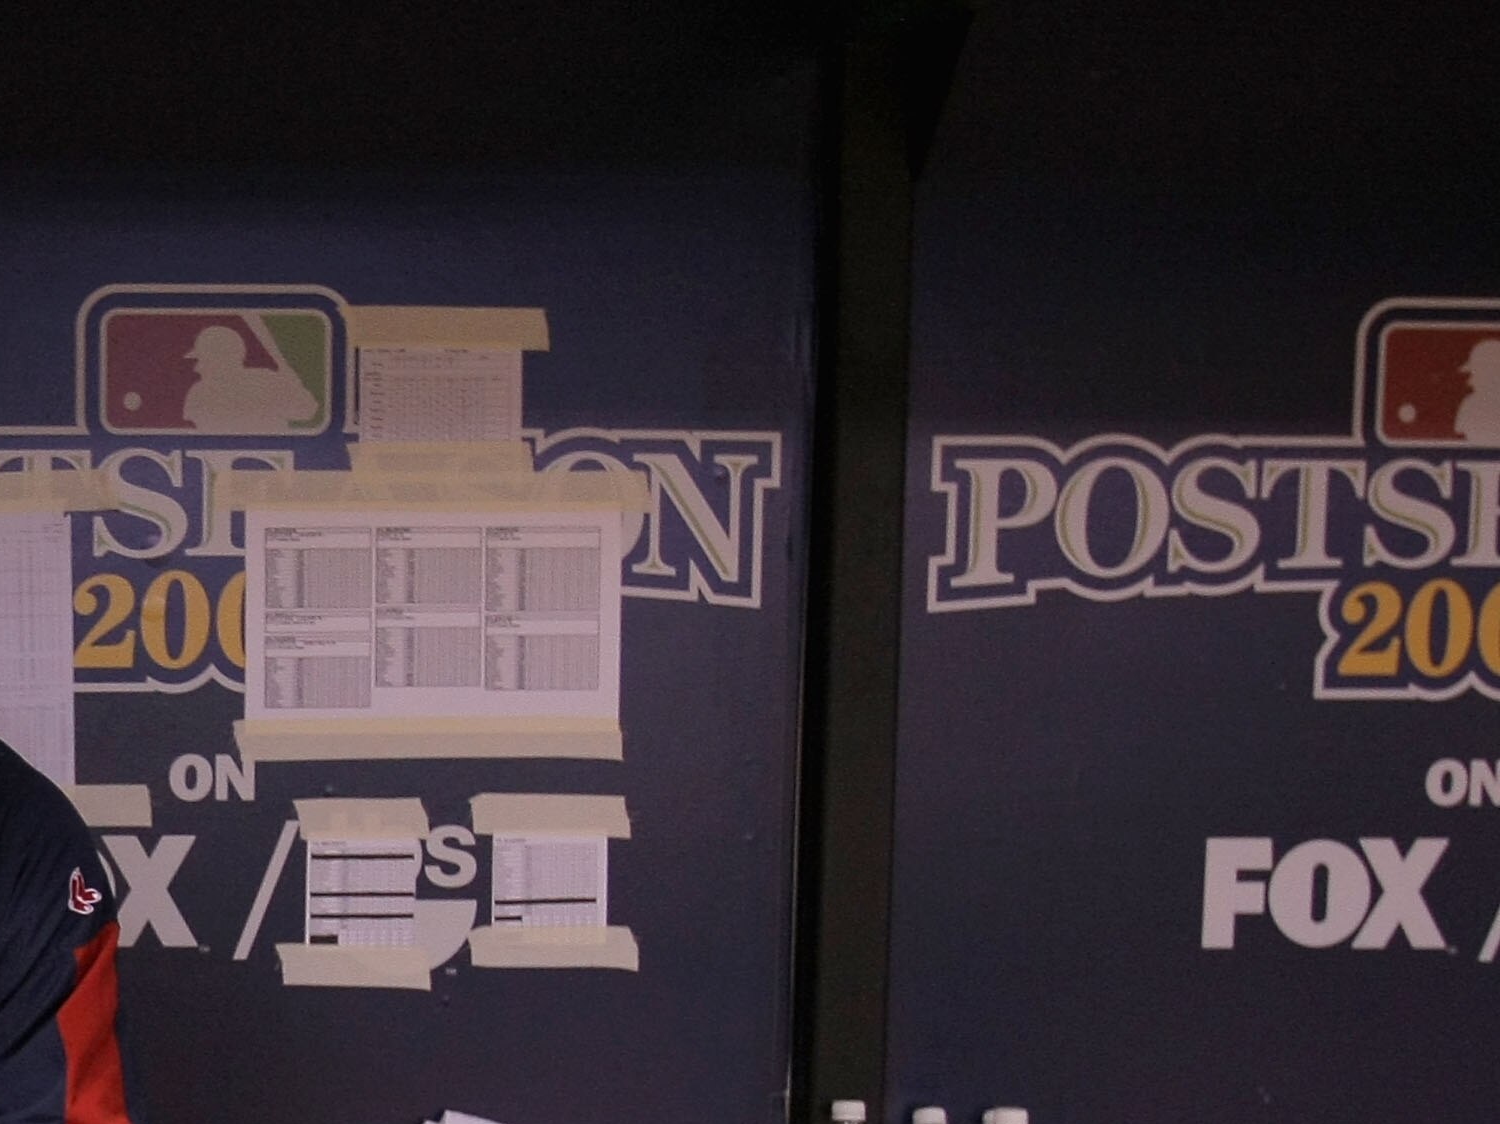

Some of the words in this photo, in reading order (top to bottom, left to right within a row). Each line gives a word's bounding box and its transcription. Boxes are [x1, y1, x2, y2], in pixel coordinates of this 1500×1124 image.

[168, 753, 256, 802] ON
[1425, 758, 1500, 808] ON
[1201, 836, 1450, 950] FOX
